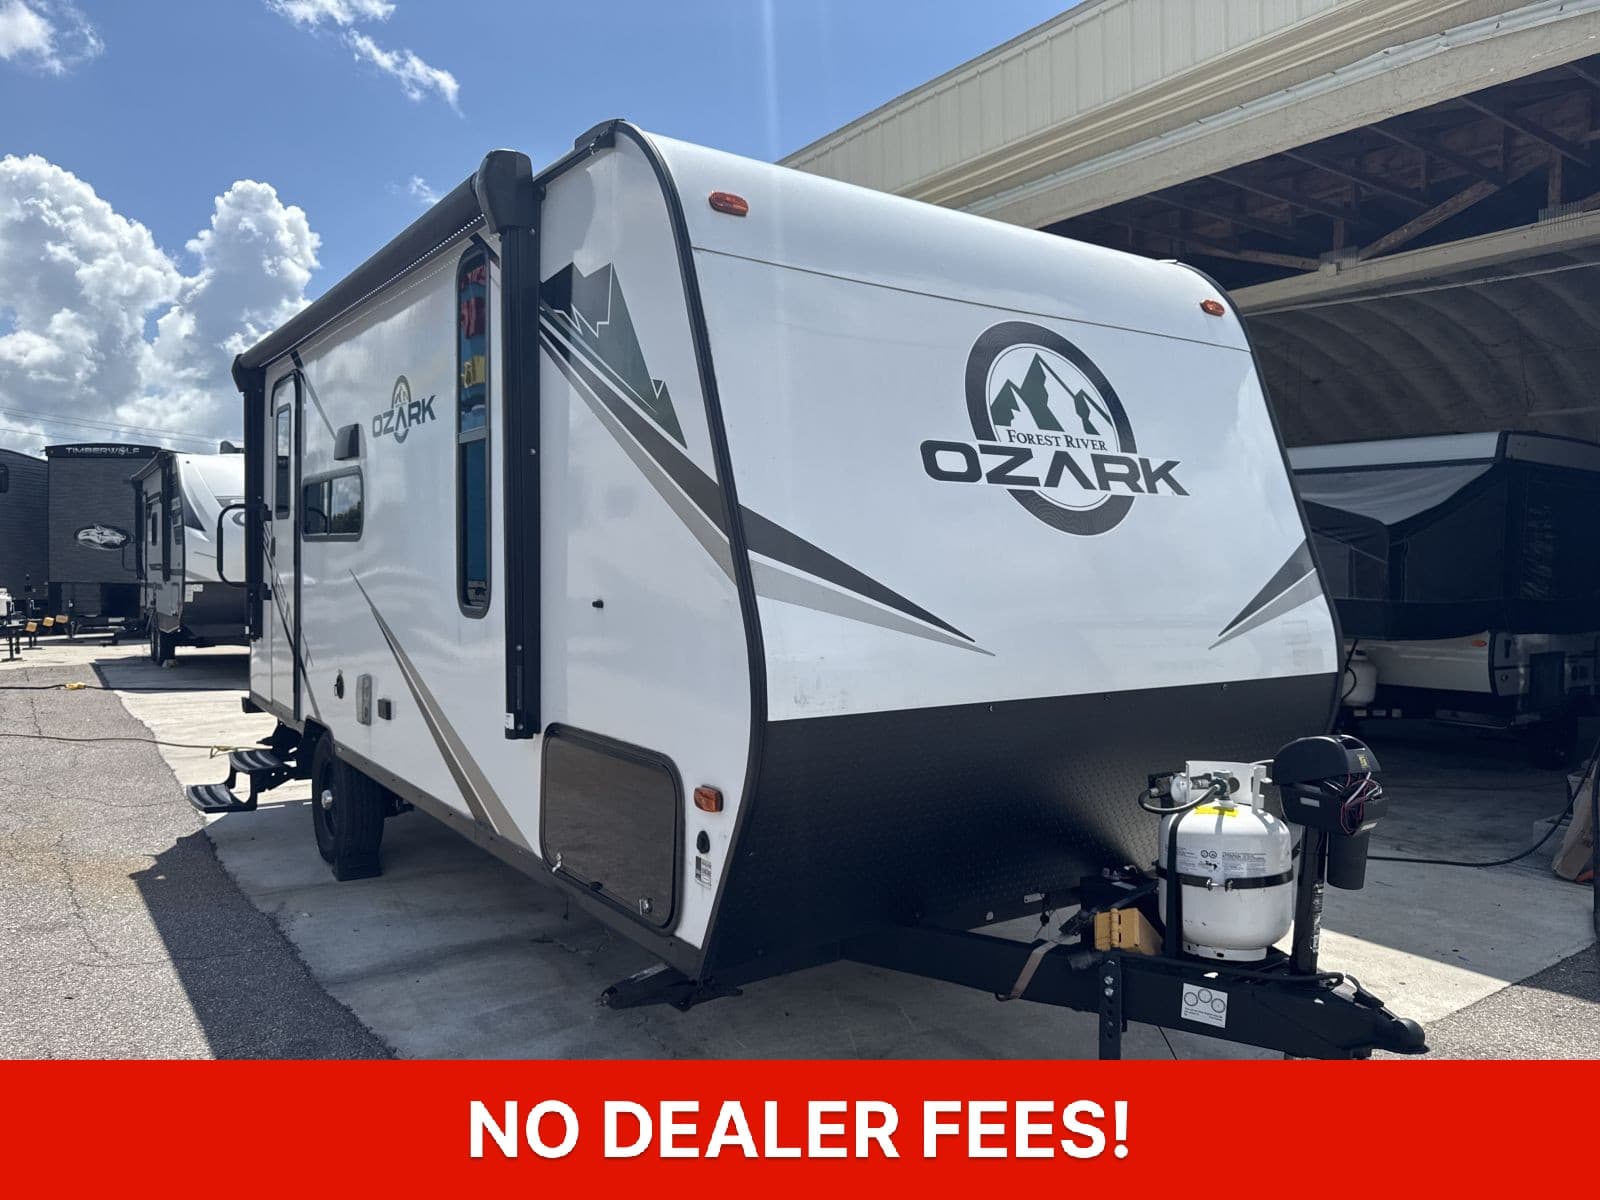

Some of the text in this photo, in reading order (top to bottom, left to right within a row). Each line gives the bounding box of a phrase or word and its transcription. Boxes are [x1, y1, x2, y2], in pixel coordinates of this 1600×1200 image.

[372, 394, 437, 438] OZARK
[65, 446, 141, 457] TIMBERWOLF
[920, 439, 1191, 497] OZARK
